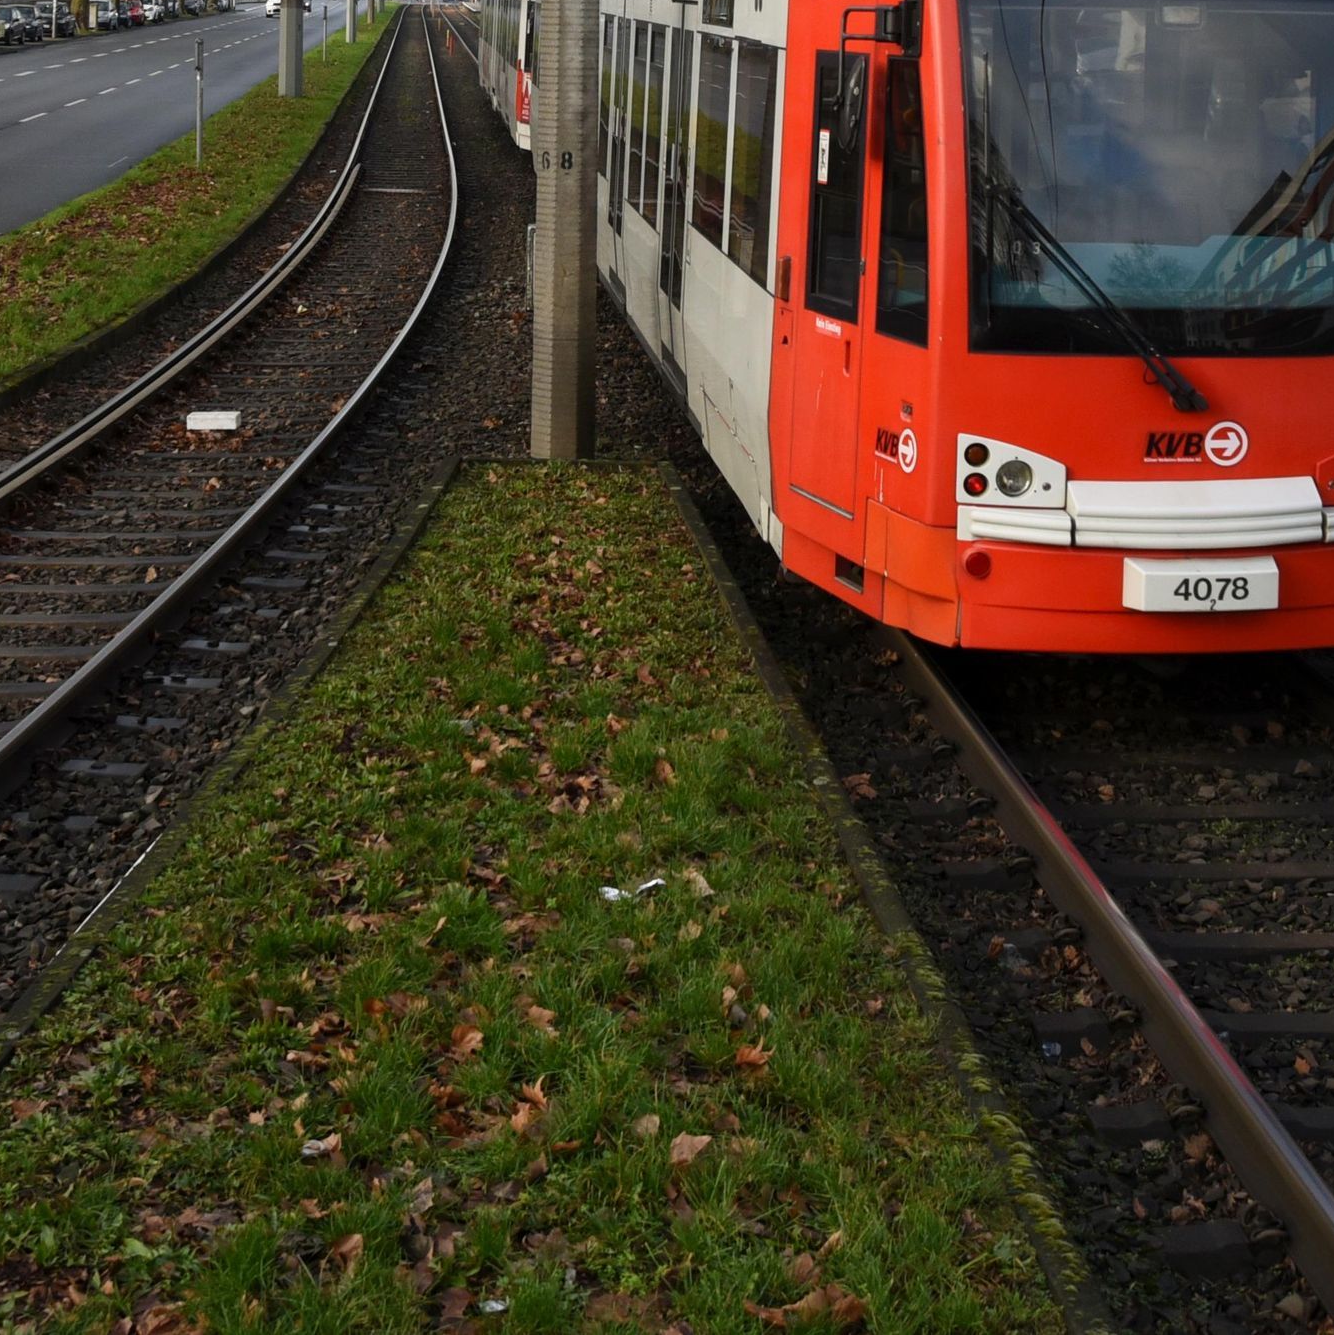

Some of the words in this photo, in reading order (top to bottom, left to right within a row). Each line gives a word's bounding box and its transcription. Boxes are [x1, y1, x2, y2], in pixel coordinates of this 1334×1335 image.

[875, 428, 899, 457] KVB
[1145, 432, 1204, 457] KVB
[1173, 577, 1250, 601] 4078
